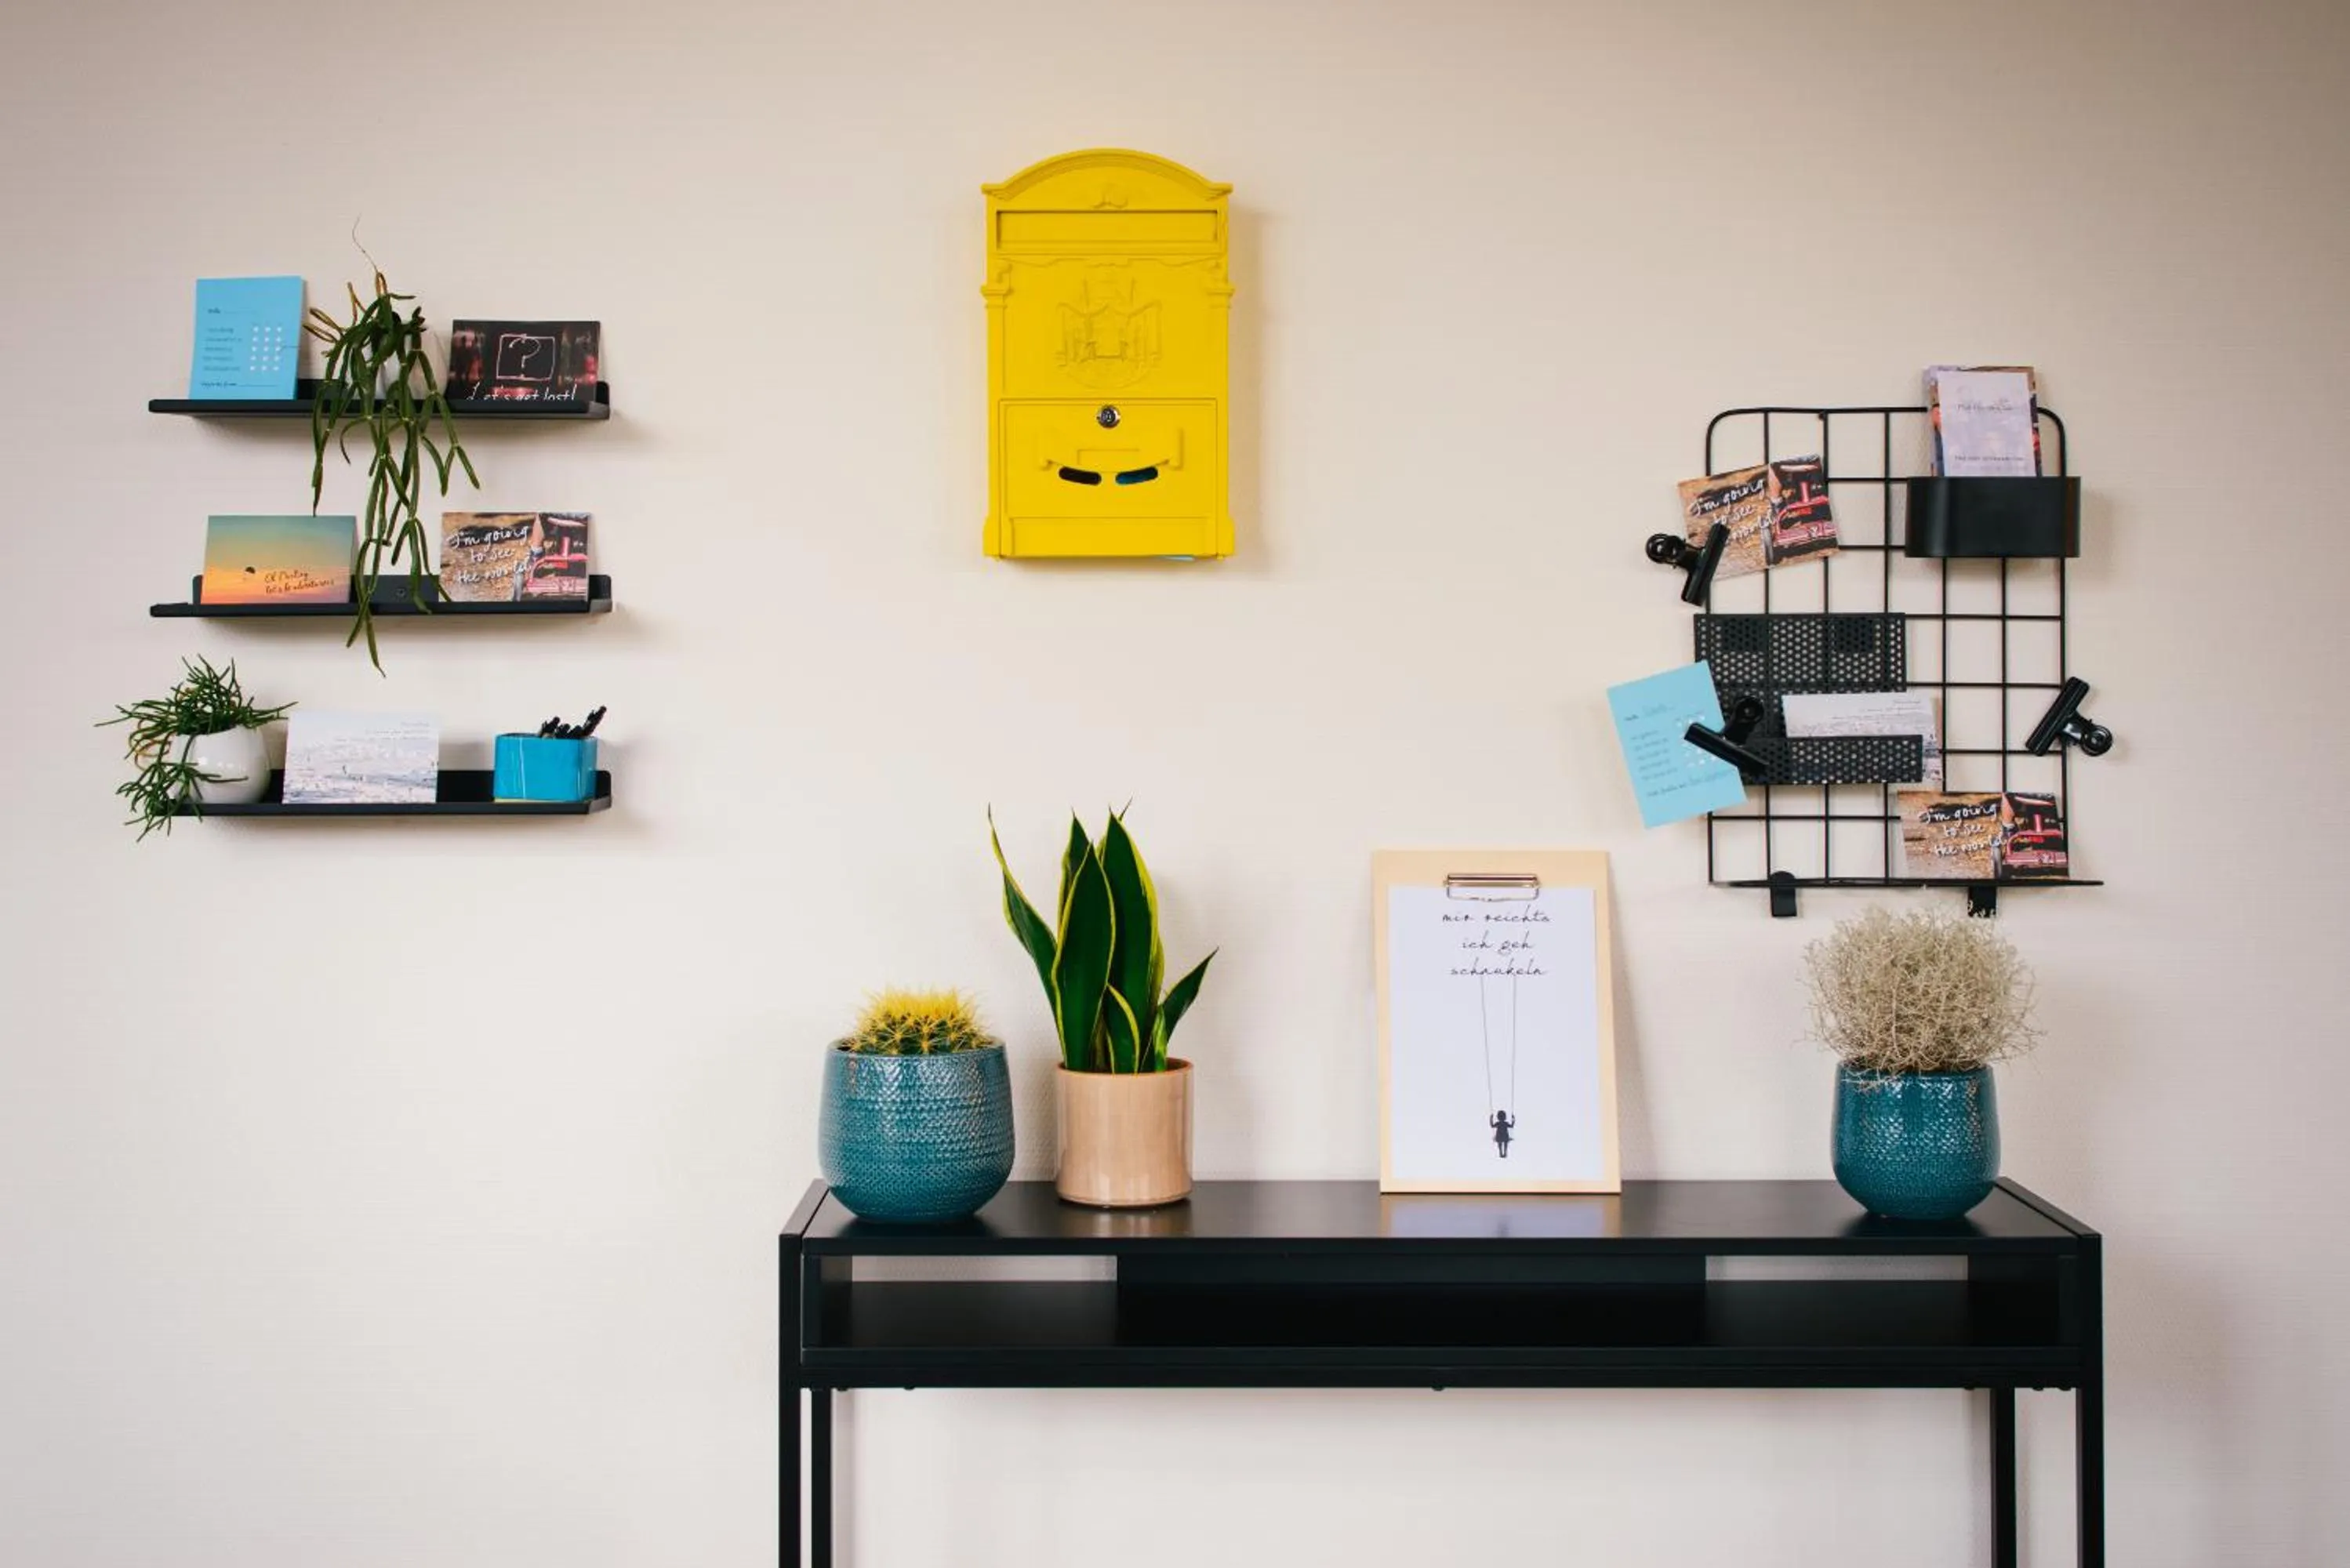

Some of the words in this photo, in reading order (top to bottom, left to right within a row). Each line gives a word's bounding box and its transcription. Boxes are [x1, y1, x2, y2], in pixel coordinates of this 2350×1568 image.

[1723, 479, 1764, 512] going
[483, 525, 529, 552] going
[470, 550, 484, 563] to
[489, 548, 514, 560] see
[1954, 804, 1997, 827] going
[1943, 824, 1957, 837] to
[1963, 824, 1985, 834] see
[1462, 929, 1493, 949] ich
[1498, 930, 1534, 956] geh
